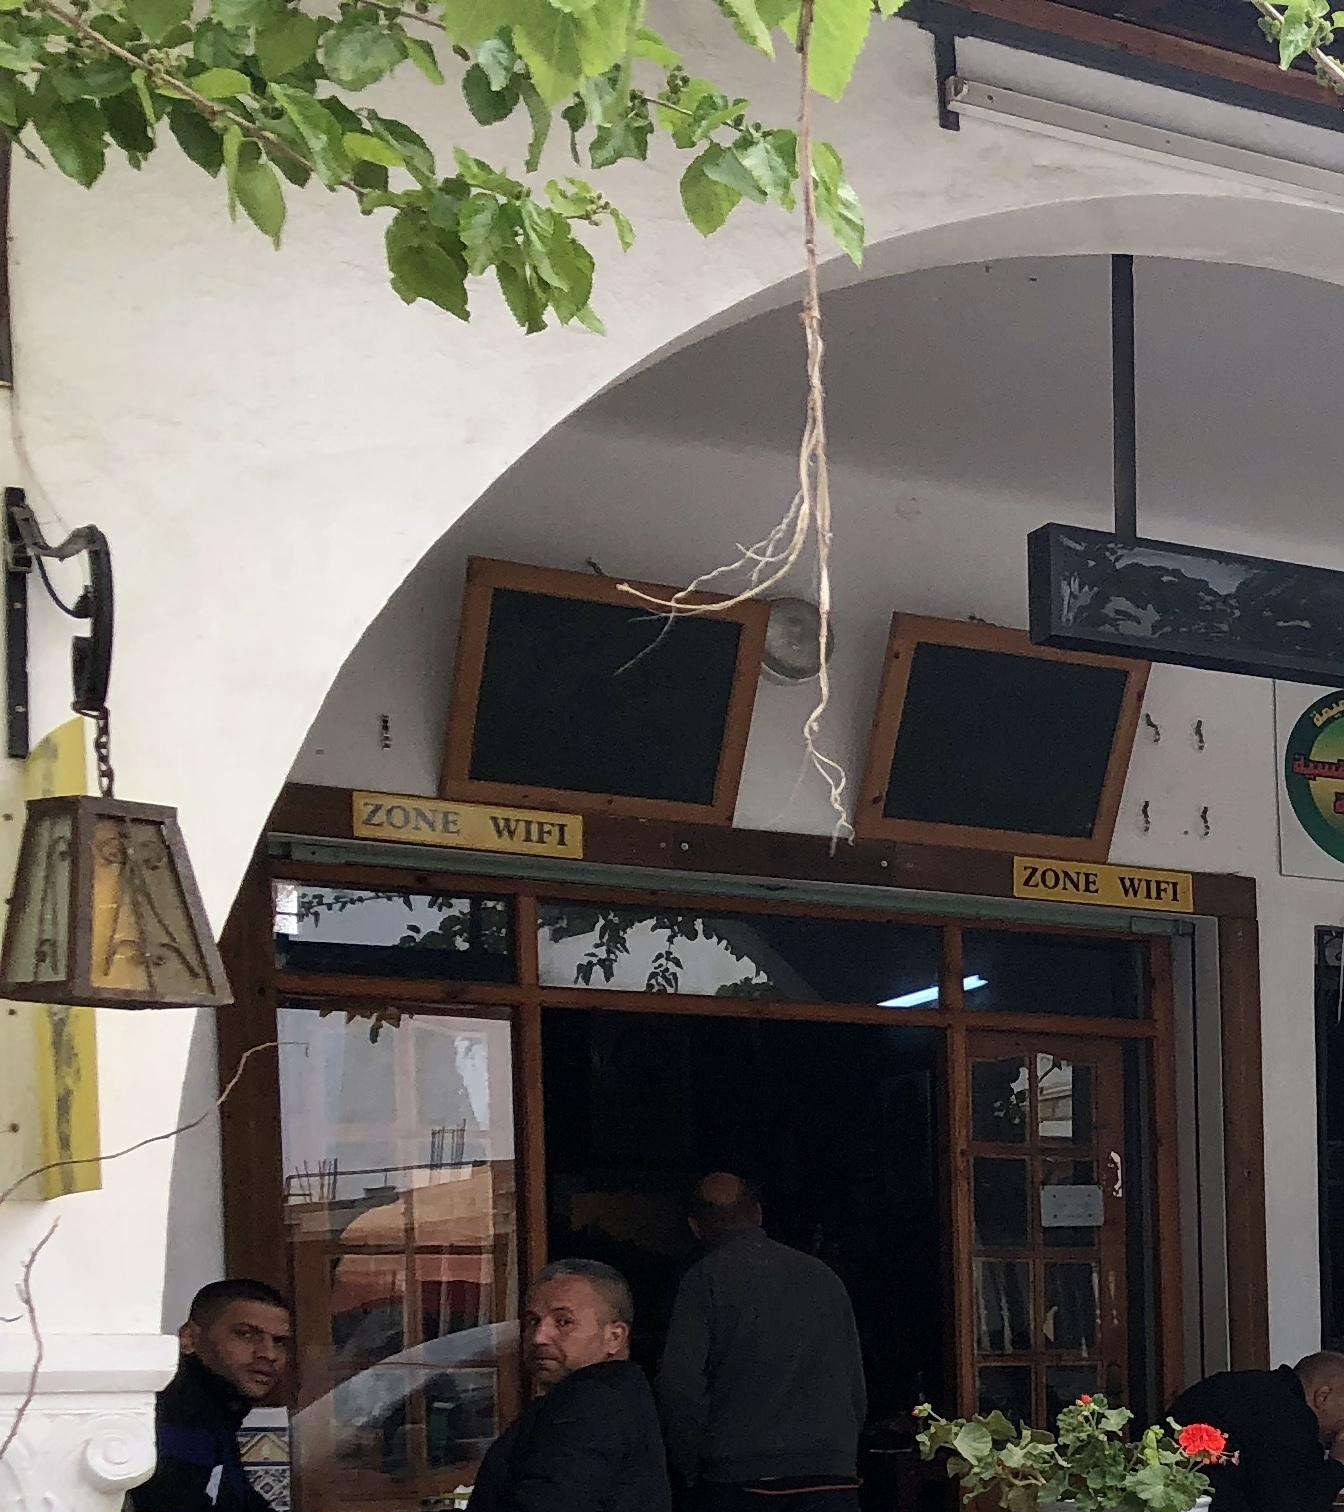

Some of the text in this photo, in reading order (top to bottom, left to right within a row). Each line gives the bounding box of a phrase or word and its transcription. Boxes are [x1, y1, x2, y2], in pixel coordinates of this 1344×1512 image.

[361, 801, 568, 847] ZONE WIFI
[1022, 865, 1180, 902] ZONE WIFI
